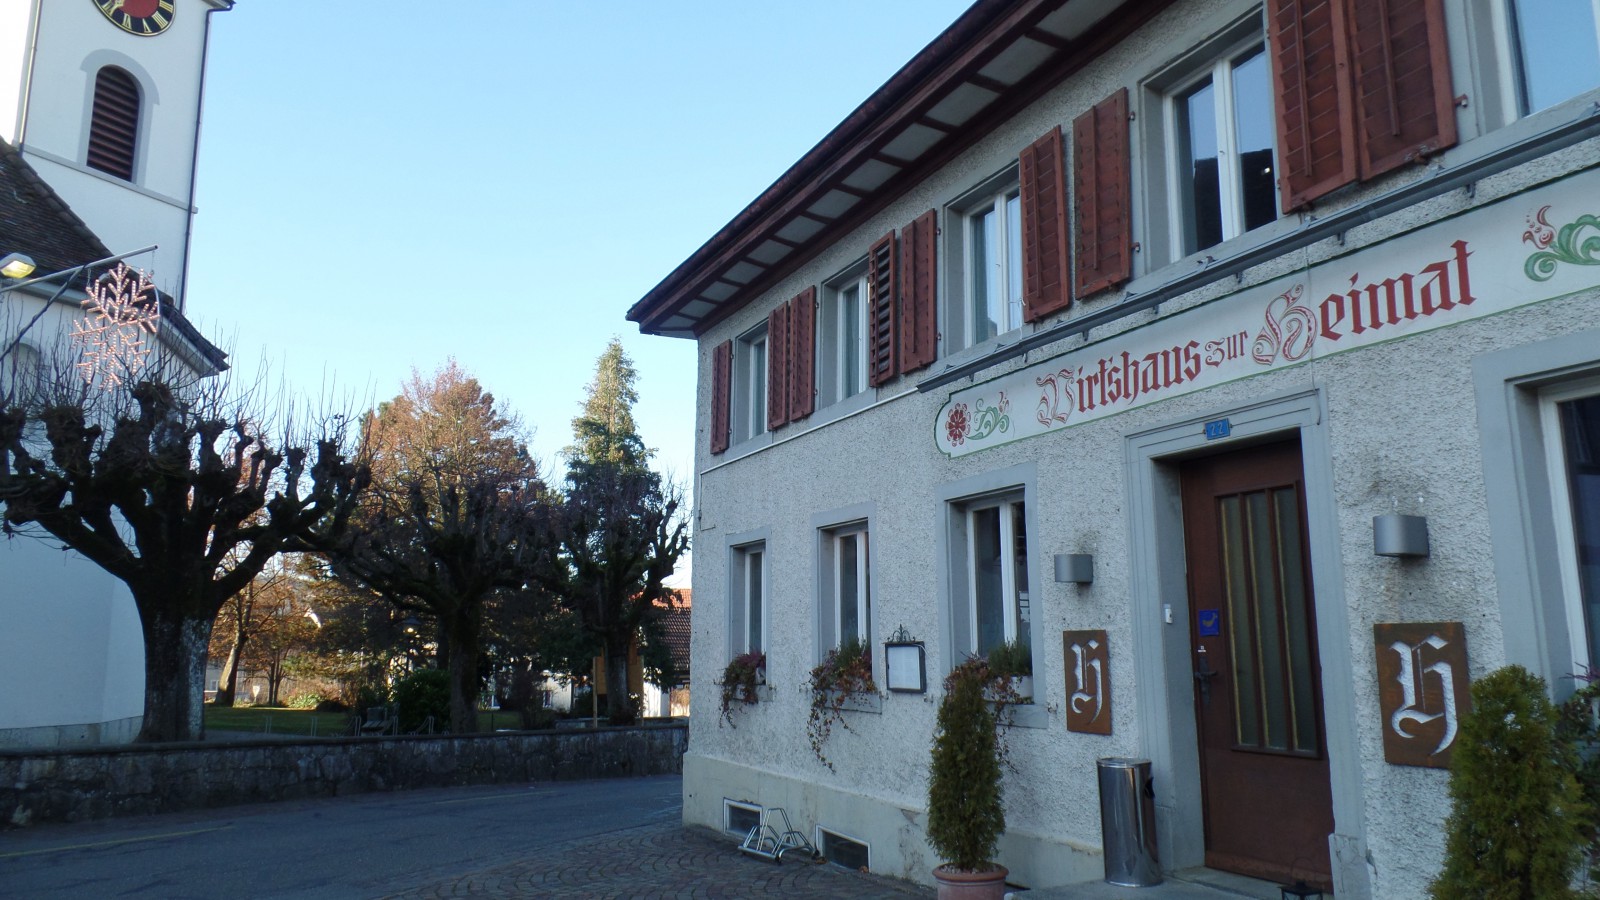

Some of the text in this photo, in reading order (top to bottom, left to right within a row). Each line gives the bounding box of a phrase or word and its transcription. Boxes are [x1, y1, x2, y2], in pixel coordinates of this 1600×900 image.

[1036, 239, 1478, 428] Wirtshaus zur Heimat
[1210, 423, 1225, 436] 22
